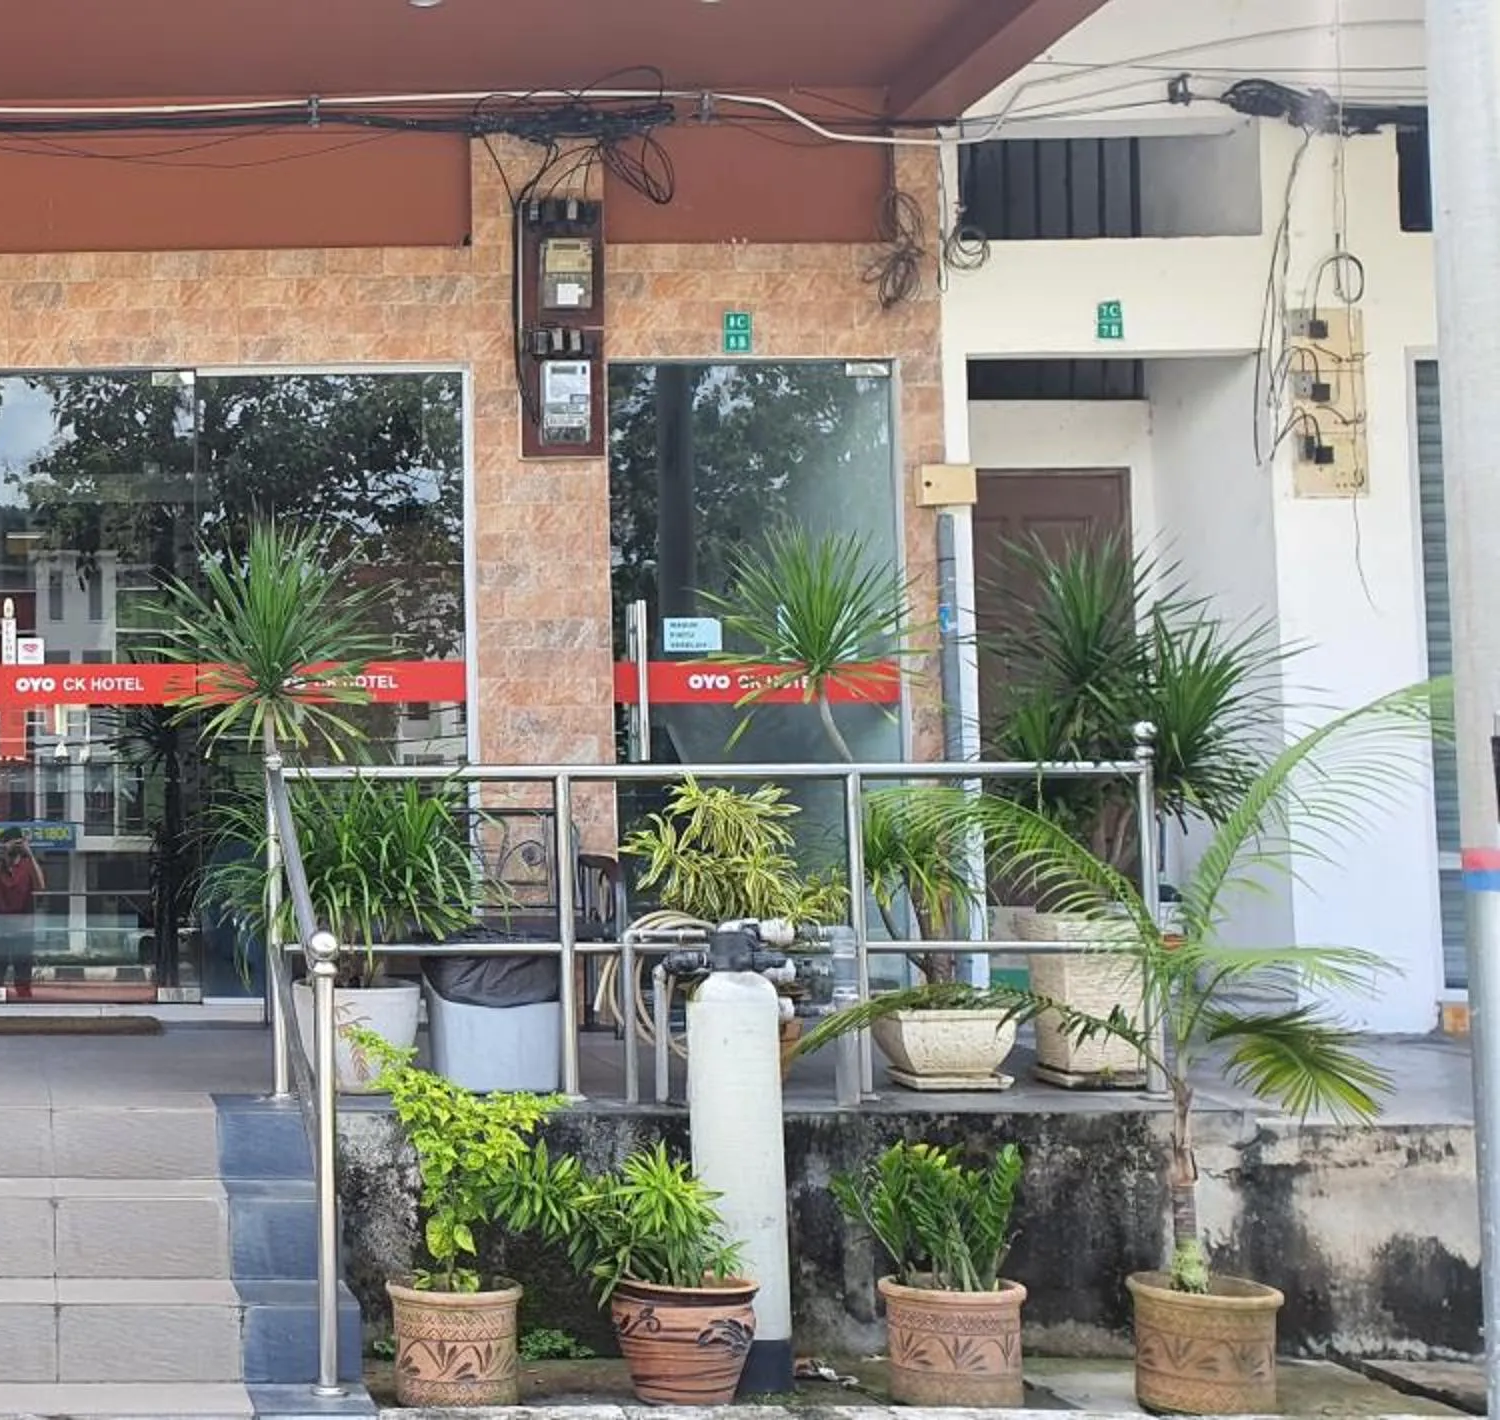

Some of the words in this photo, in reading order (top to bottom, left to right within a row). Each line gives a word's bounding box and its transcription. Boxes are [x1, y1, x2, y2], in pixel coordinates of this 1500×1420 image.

[15, 677, 56, 693] OYO
[62, 677, 87, 692] CK
[90, 676, 145, 692] HOTEL
[688, 673, 731, 689] OYO
